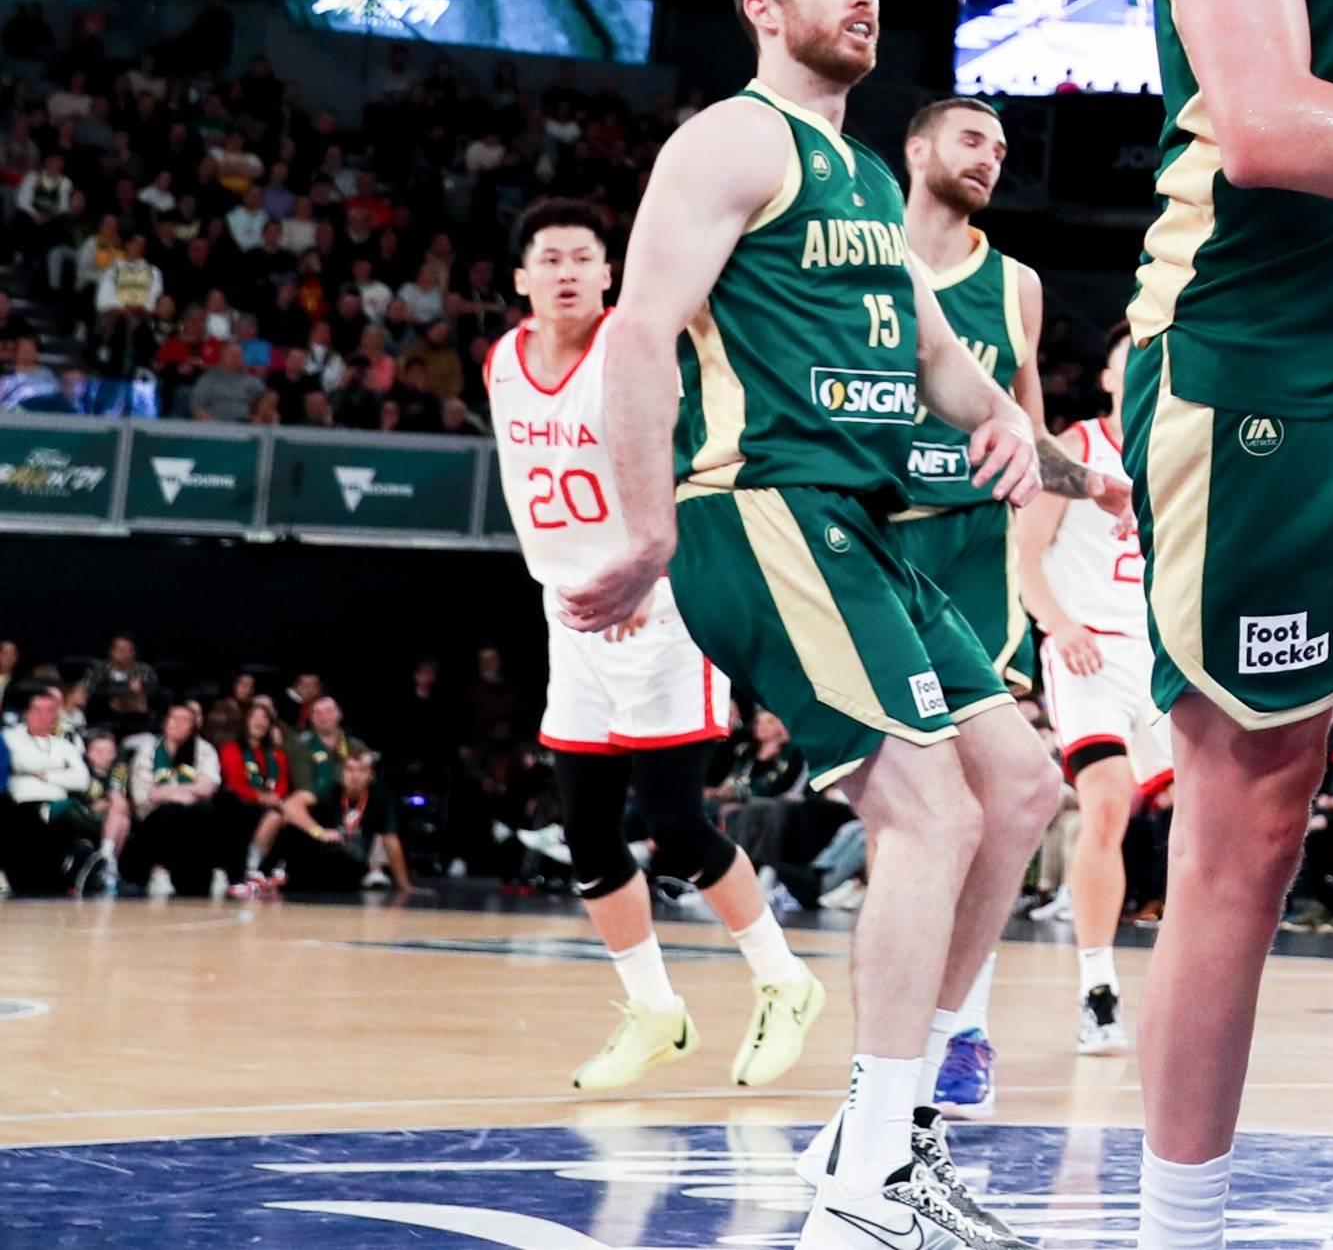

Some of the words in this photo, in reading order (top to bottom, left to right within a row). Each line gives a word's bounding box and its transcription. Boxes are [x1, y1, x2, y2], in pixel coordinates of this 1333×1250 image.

[801, 219, 908, 270] AUSTRA
[862, 293, 901, 349] 15
[843, 380, 916, 414] SIGN
[509, 420, 598, 447] CHINA
[906, 448, 961, 476] NET
[528, 466, 610, 529] 20
[1246, 620, 1300, 644] Foot
[1246, 640, 1325, 668] Locker
